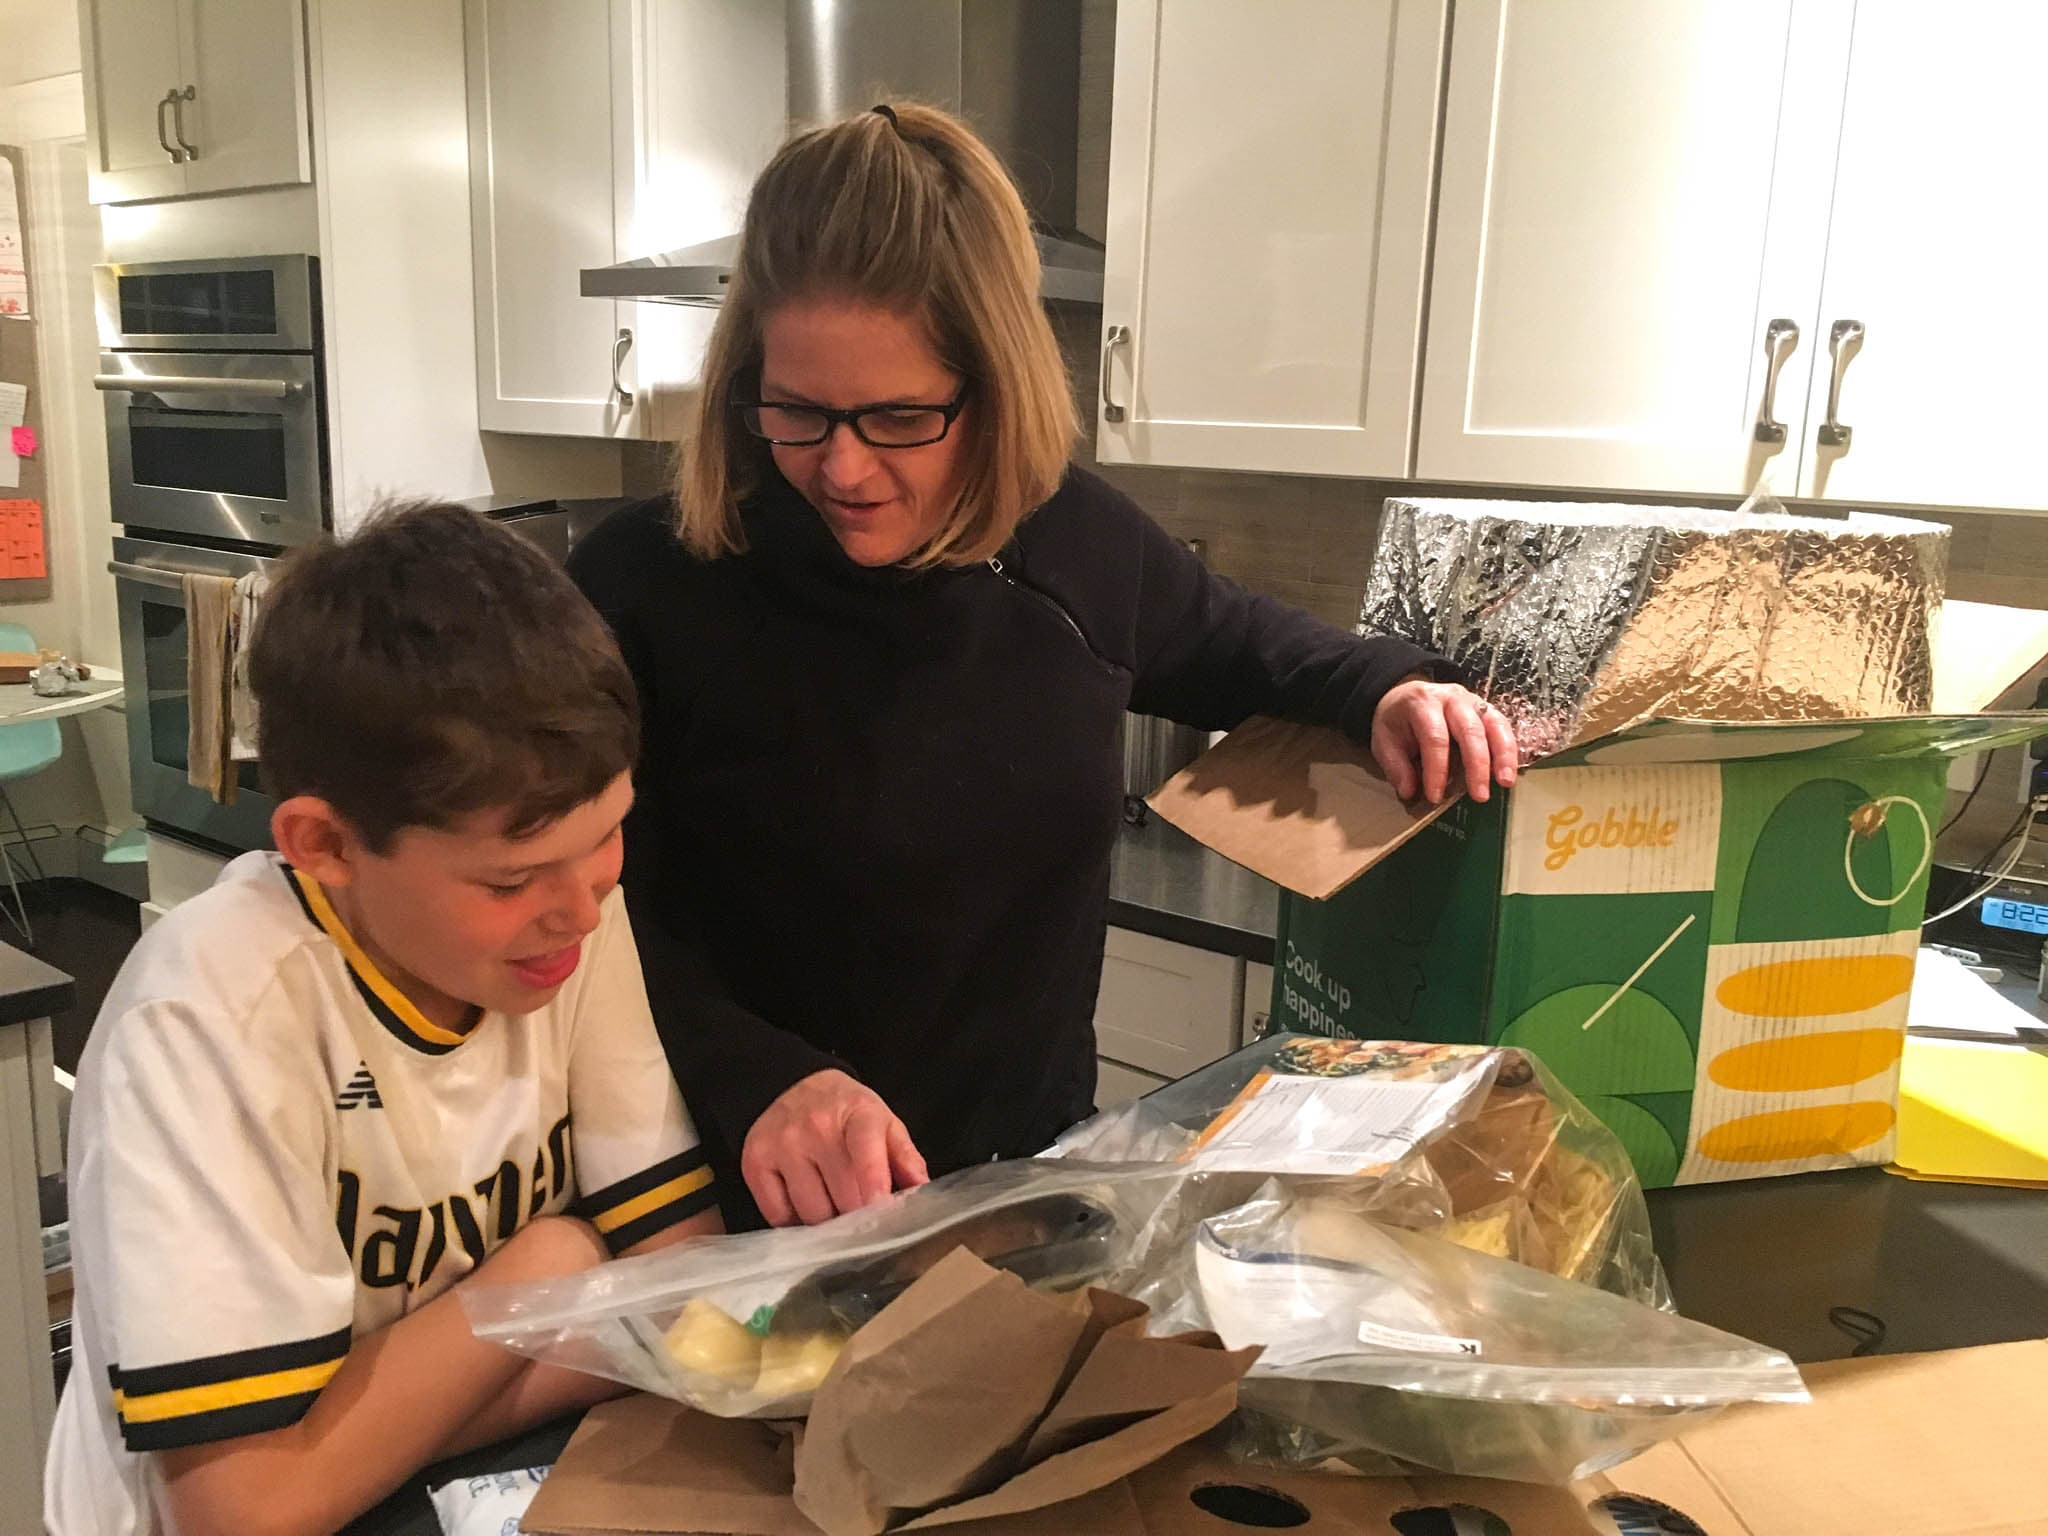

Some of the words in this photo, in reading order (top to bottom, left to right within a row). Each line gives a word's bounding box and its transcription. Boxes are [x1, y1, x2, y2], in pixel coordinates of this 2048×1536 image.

[1544, 804, 1680, 871] Gobble
[1286, 939, 1325, 993] Cook
[1327, 977, 1352, 1015] up
